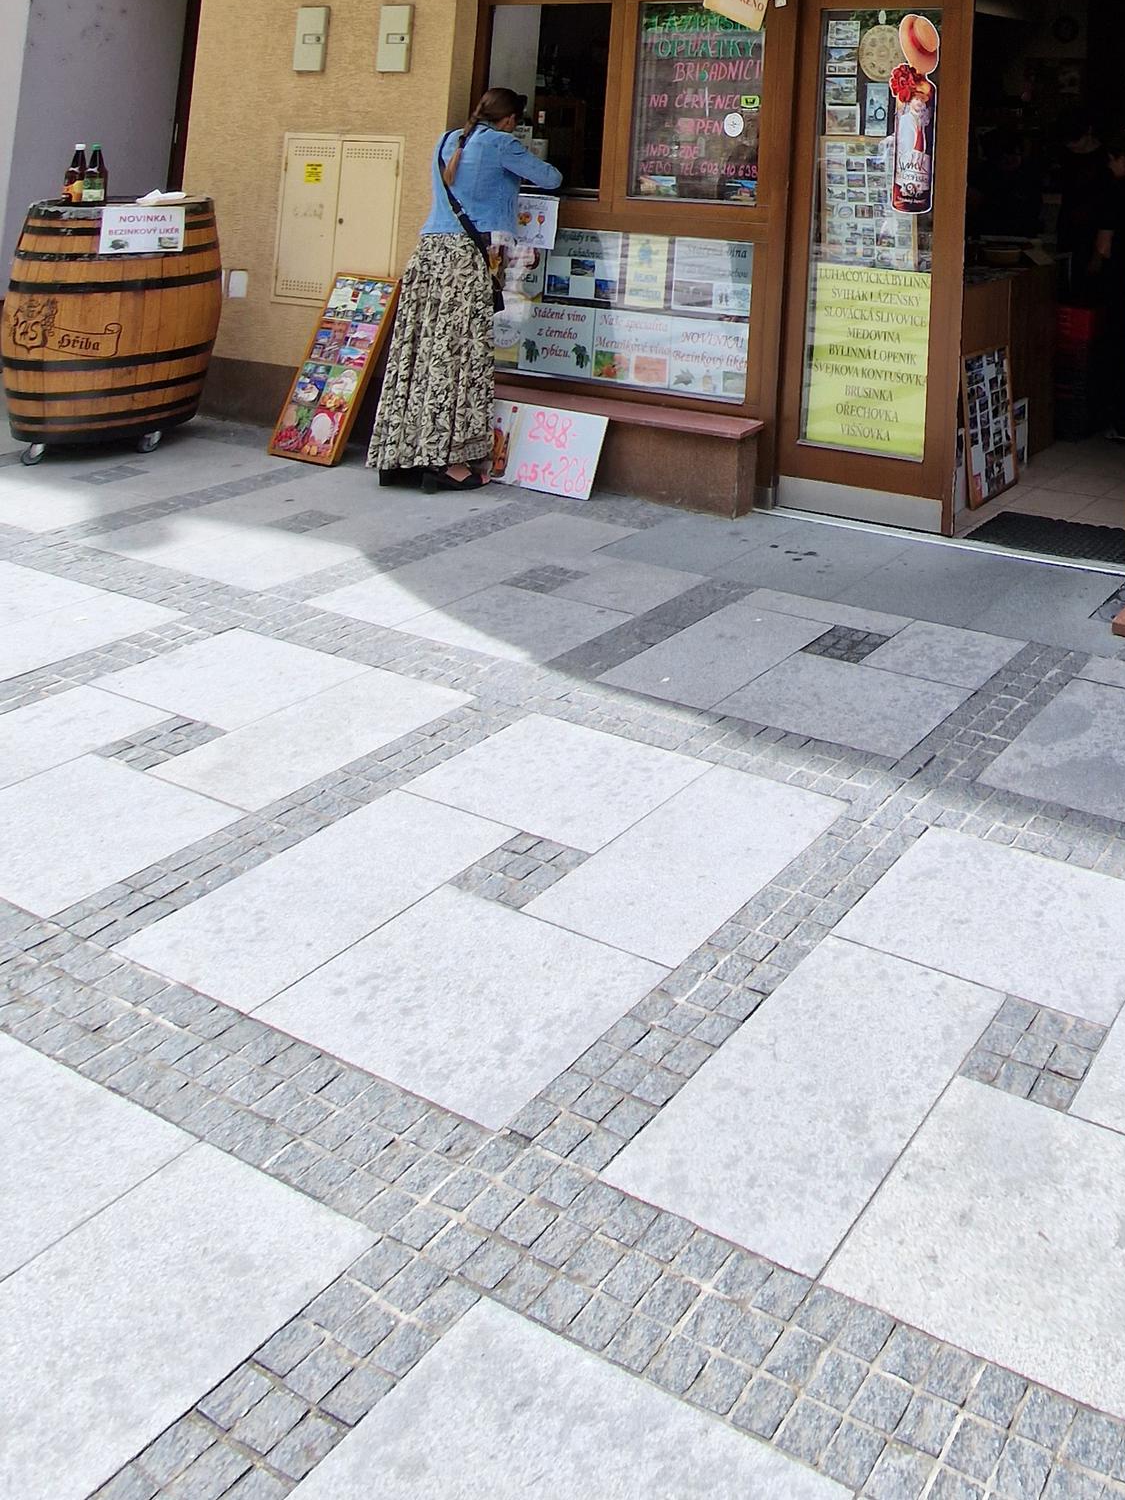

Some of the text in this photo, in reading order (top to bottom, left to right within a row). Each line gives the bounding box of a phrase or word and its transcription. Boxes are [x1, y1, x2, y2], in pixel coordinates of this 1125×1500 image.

[649, 90, 740, 110] NA ČERVENEC
[645, 143, 670, 157] INFO
[119, 215, 167, 223] NOVINKA
[108, 226, 179, 236] BEZINKOVÝ LIKÉR
[819, 268, 890, 285] LUHAČOVICKÁ
[531, 306, 587, 323] Stáčené víno
[824, 305, 927, 328] SLOVÁCKÁ SLIVOVICE
[537, 326, 578, 340] z černého
[682, 331, 744, 349] NOVINKA!
[846, 327, 900, 343] MEDOVINA
[541, 344, 571, 361] rybízu.
[673, 350, 723, 369] Bezinkový
[828, 343, 872, 360] BYLINNÁ
[844, 385, 894, 402] BRUSINKA
[835, 402, 899, 423] OŘECHOVKA
[840, 422, 891, 442] VIŠŇOVKA
